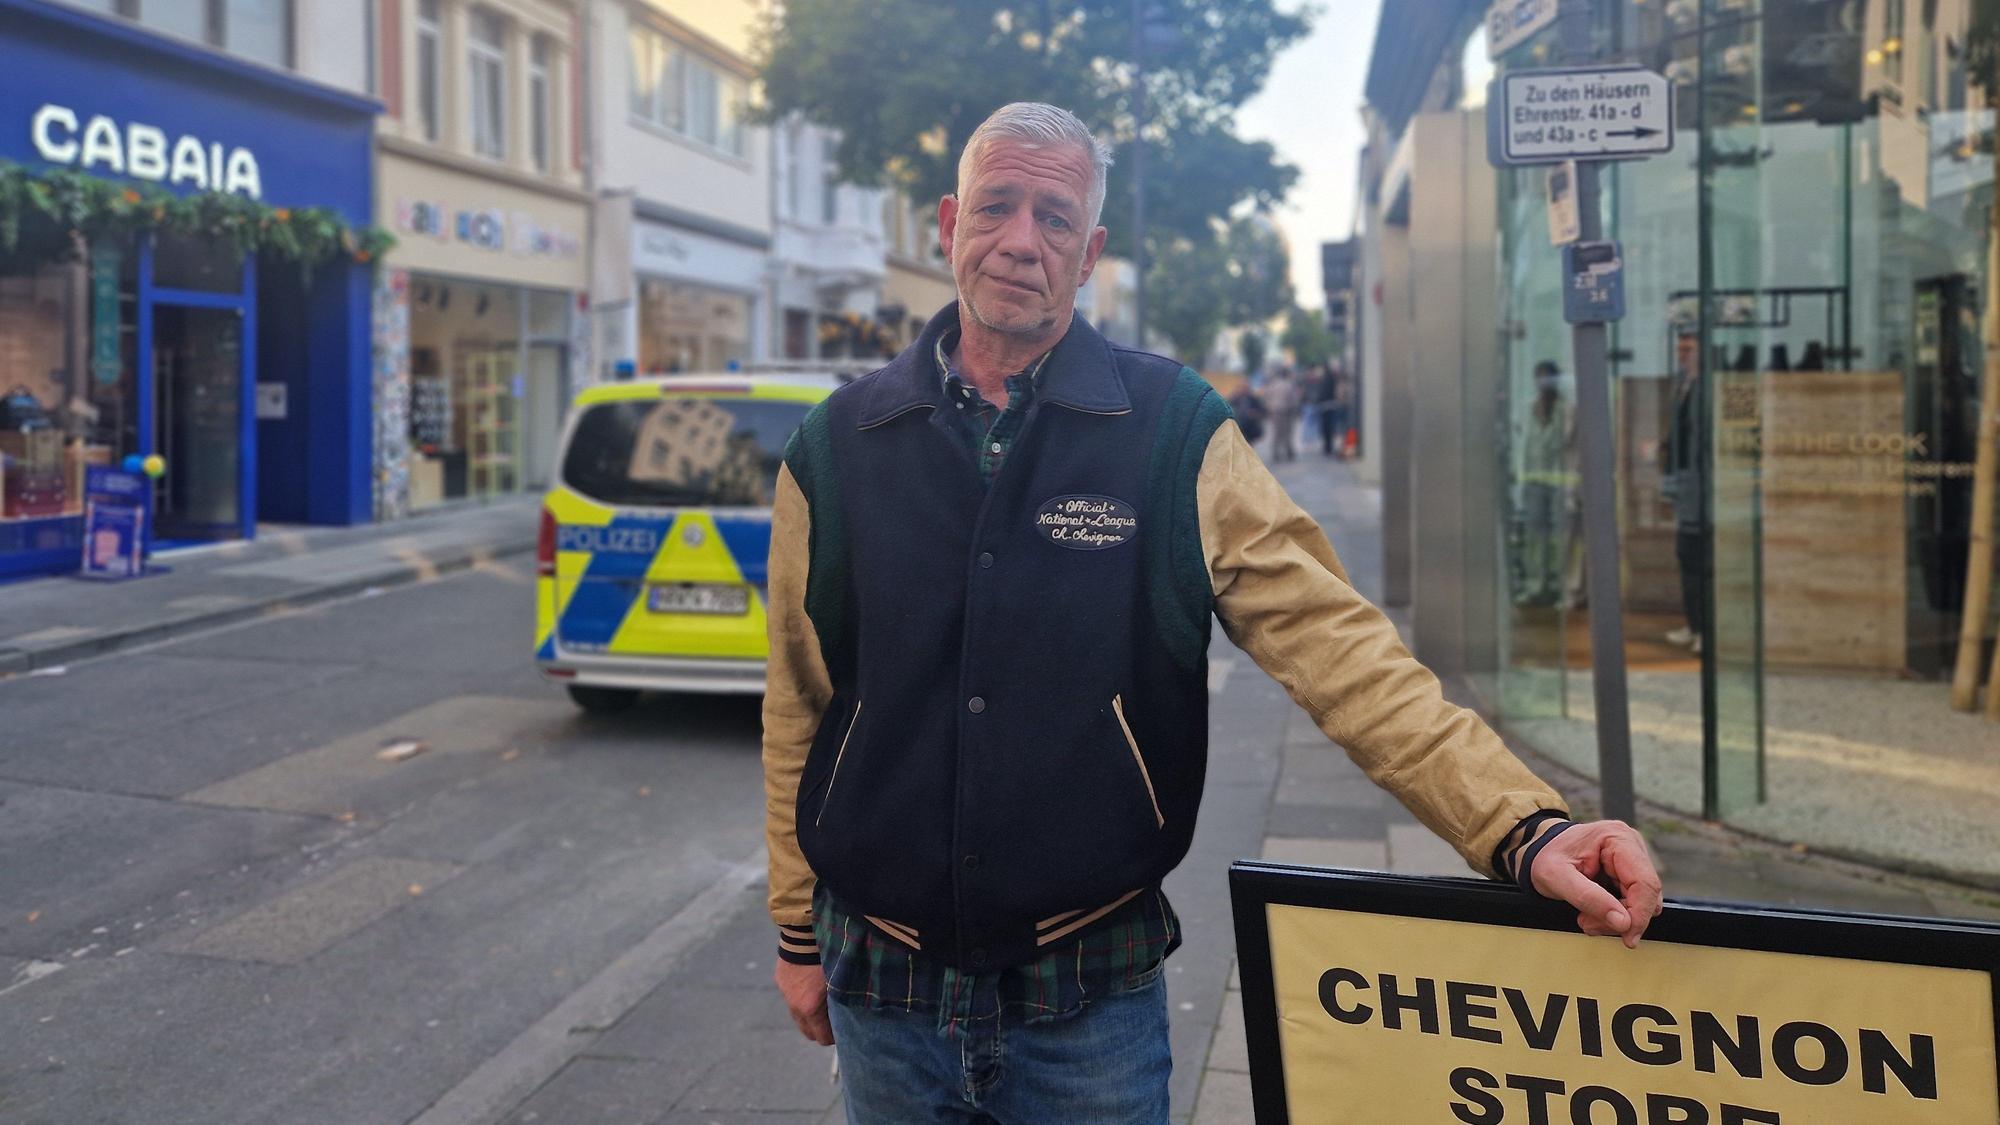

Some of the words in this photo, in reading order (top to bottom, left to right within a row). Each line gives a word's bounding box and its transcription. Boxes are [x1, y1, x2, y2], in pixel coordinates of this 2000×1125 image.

[1526, 86, 1546, 102] Zu
[1551, 85, 1580, 100] den
[1584, 83, 1650, 100] Häusern
[1514, 105, 1585, 124] Ehrenstr.
[1588, 104, 1617, 121] 41a
[1631, 103, 1642, 119] d
[1514, 127, 1544, 144] und
[1548, 126, 1575, 143] 43a
[1588, 128, 1599, 142] c
[32, 103, 262, 200] CABAIA
[1848, 432, 1929, 456] LOOK
[1065, 500, 1109, 513] Official
[1037, 513, 1084, 525] National
[1090, 514, 1136, 529] League
[557, 526, 657, 551] POLIZEI
[1317, 967, 1939, 1100] CHEVIGNON
